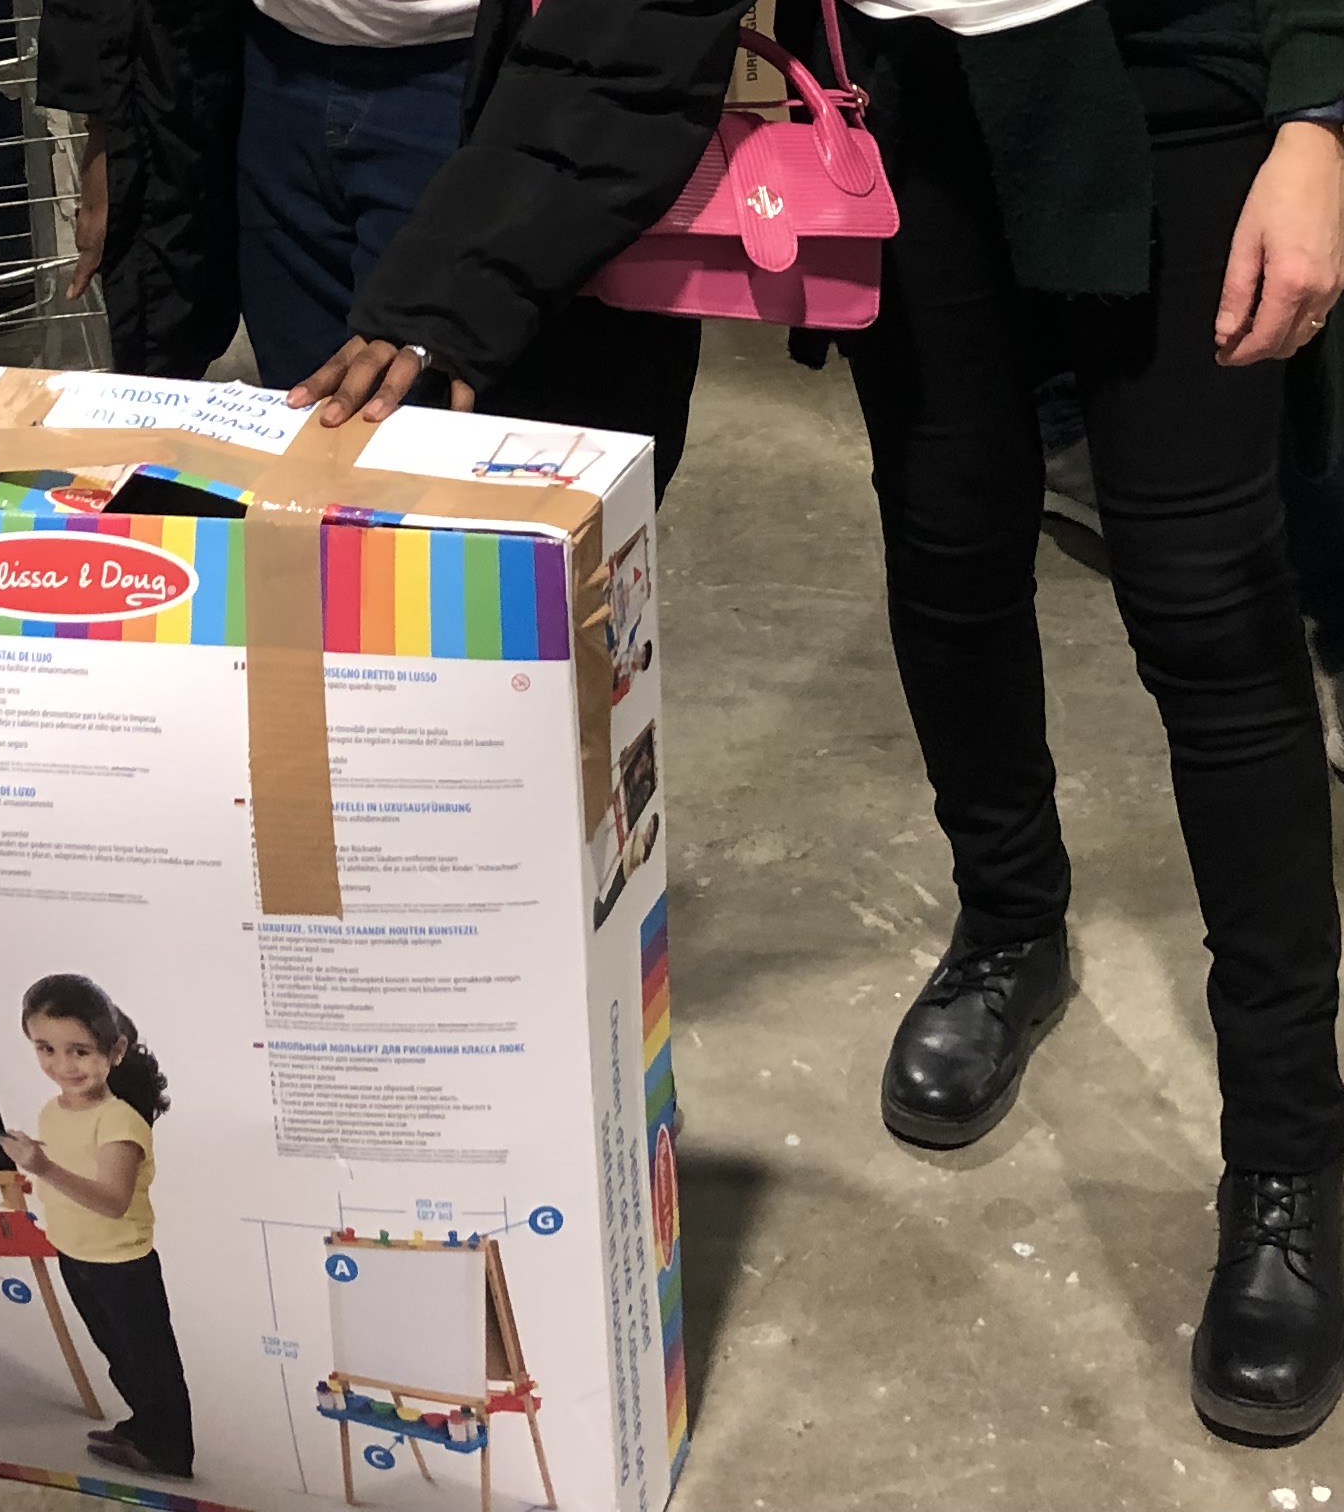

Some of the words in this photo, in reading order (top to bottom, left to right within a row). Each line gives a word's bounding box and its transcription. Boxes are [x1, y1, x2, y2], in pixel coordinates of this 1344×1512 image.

[80, 561, 93, 587] &
[100, 561, 168, 607] Doug
[19, 651, 30, 662] DE
[32, 652, 53, 663] LUJO
[362, 669, 395, 680] ERETTO
[397, 670, 407, 681] DI
[409, 671, 437, 683] LUSSO
[0, 786, 11, 796] DE
[14, 787, 37, 798] LUXO
[367, 802, 377, 811] IN
[379, 801, 472, 813] LUXUSAUSFÜHRUNG
[345, 926, 386, 936] STAANDE
[609, 999, 623, 1121] Chevalet
[435, 1200, 453, 1209] cm
[536, 1211, 555, 1229] G
[335, 1260, 351, 1277] A
